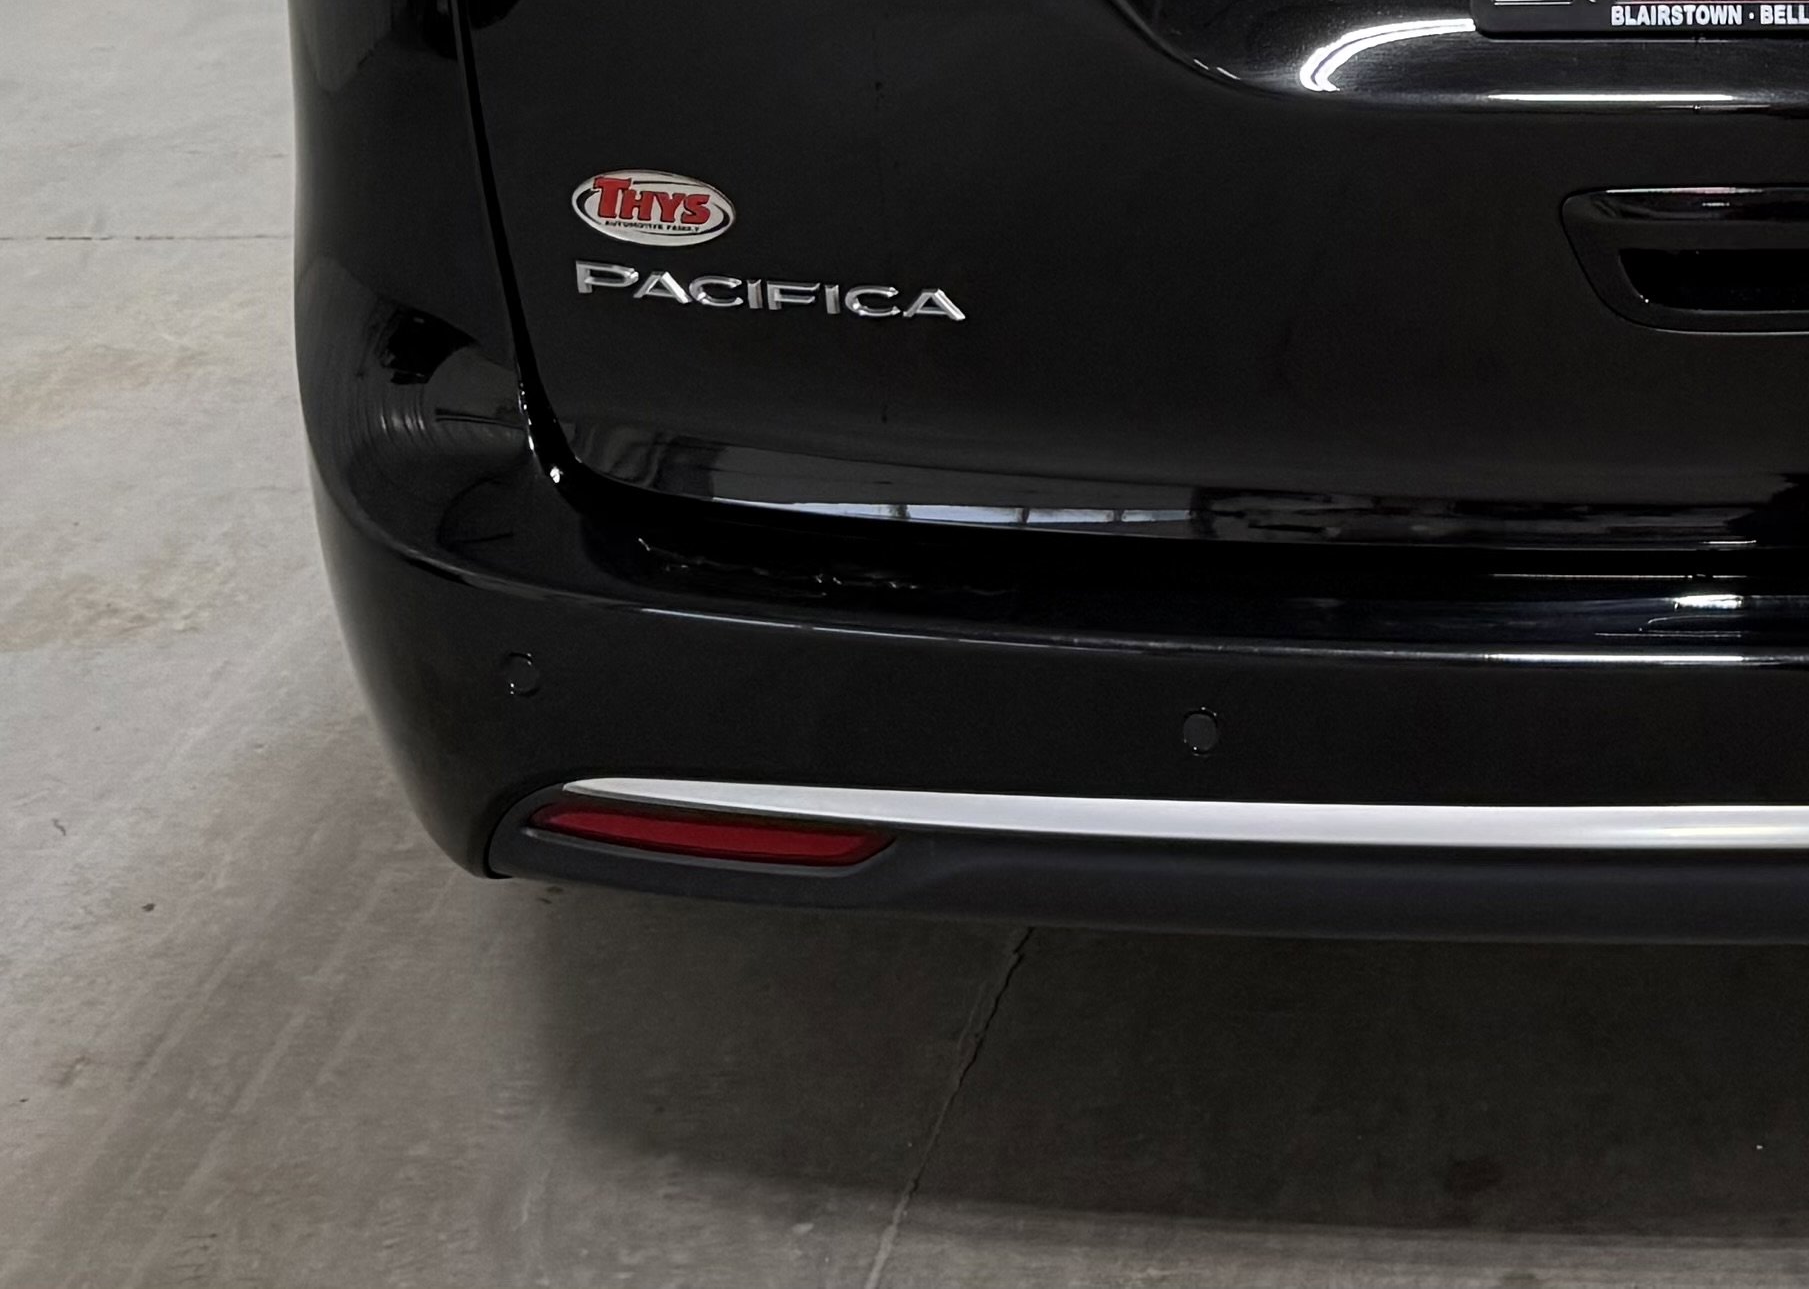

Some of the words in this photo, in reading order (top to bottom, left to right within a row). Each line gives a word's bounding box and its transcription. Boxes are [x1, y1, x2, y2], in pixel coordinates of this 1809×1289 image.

[1611, 4, 1742, 25] BLAIRSTOWN
[593, 176, 711, 225] THYS
[575, 260, 966, 322] PACIFICA
